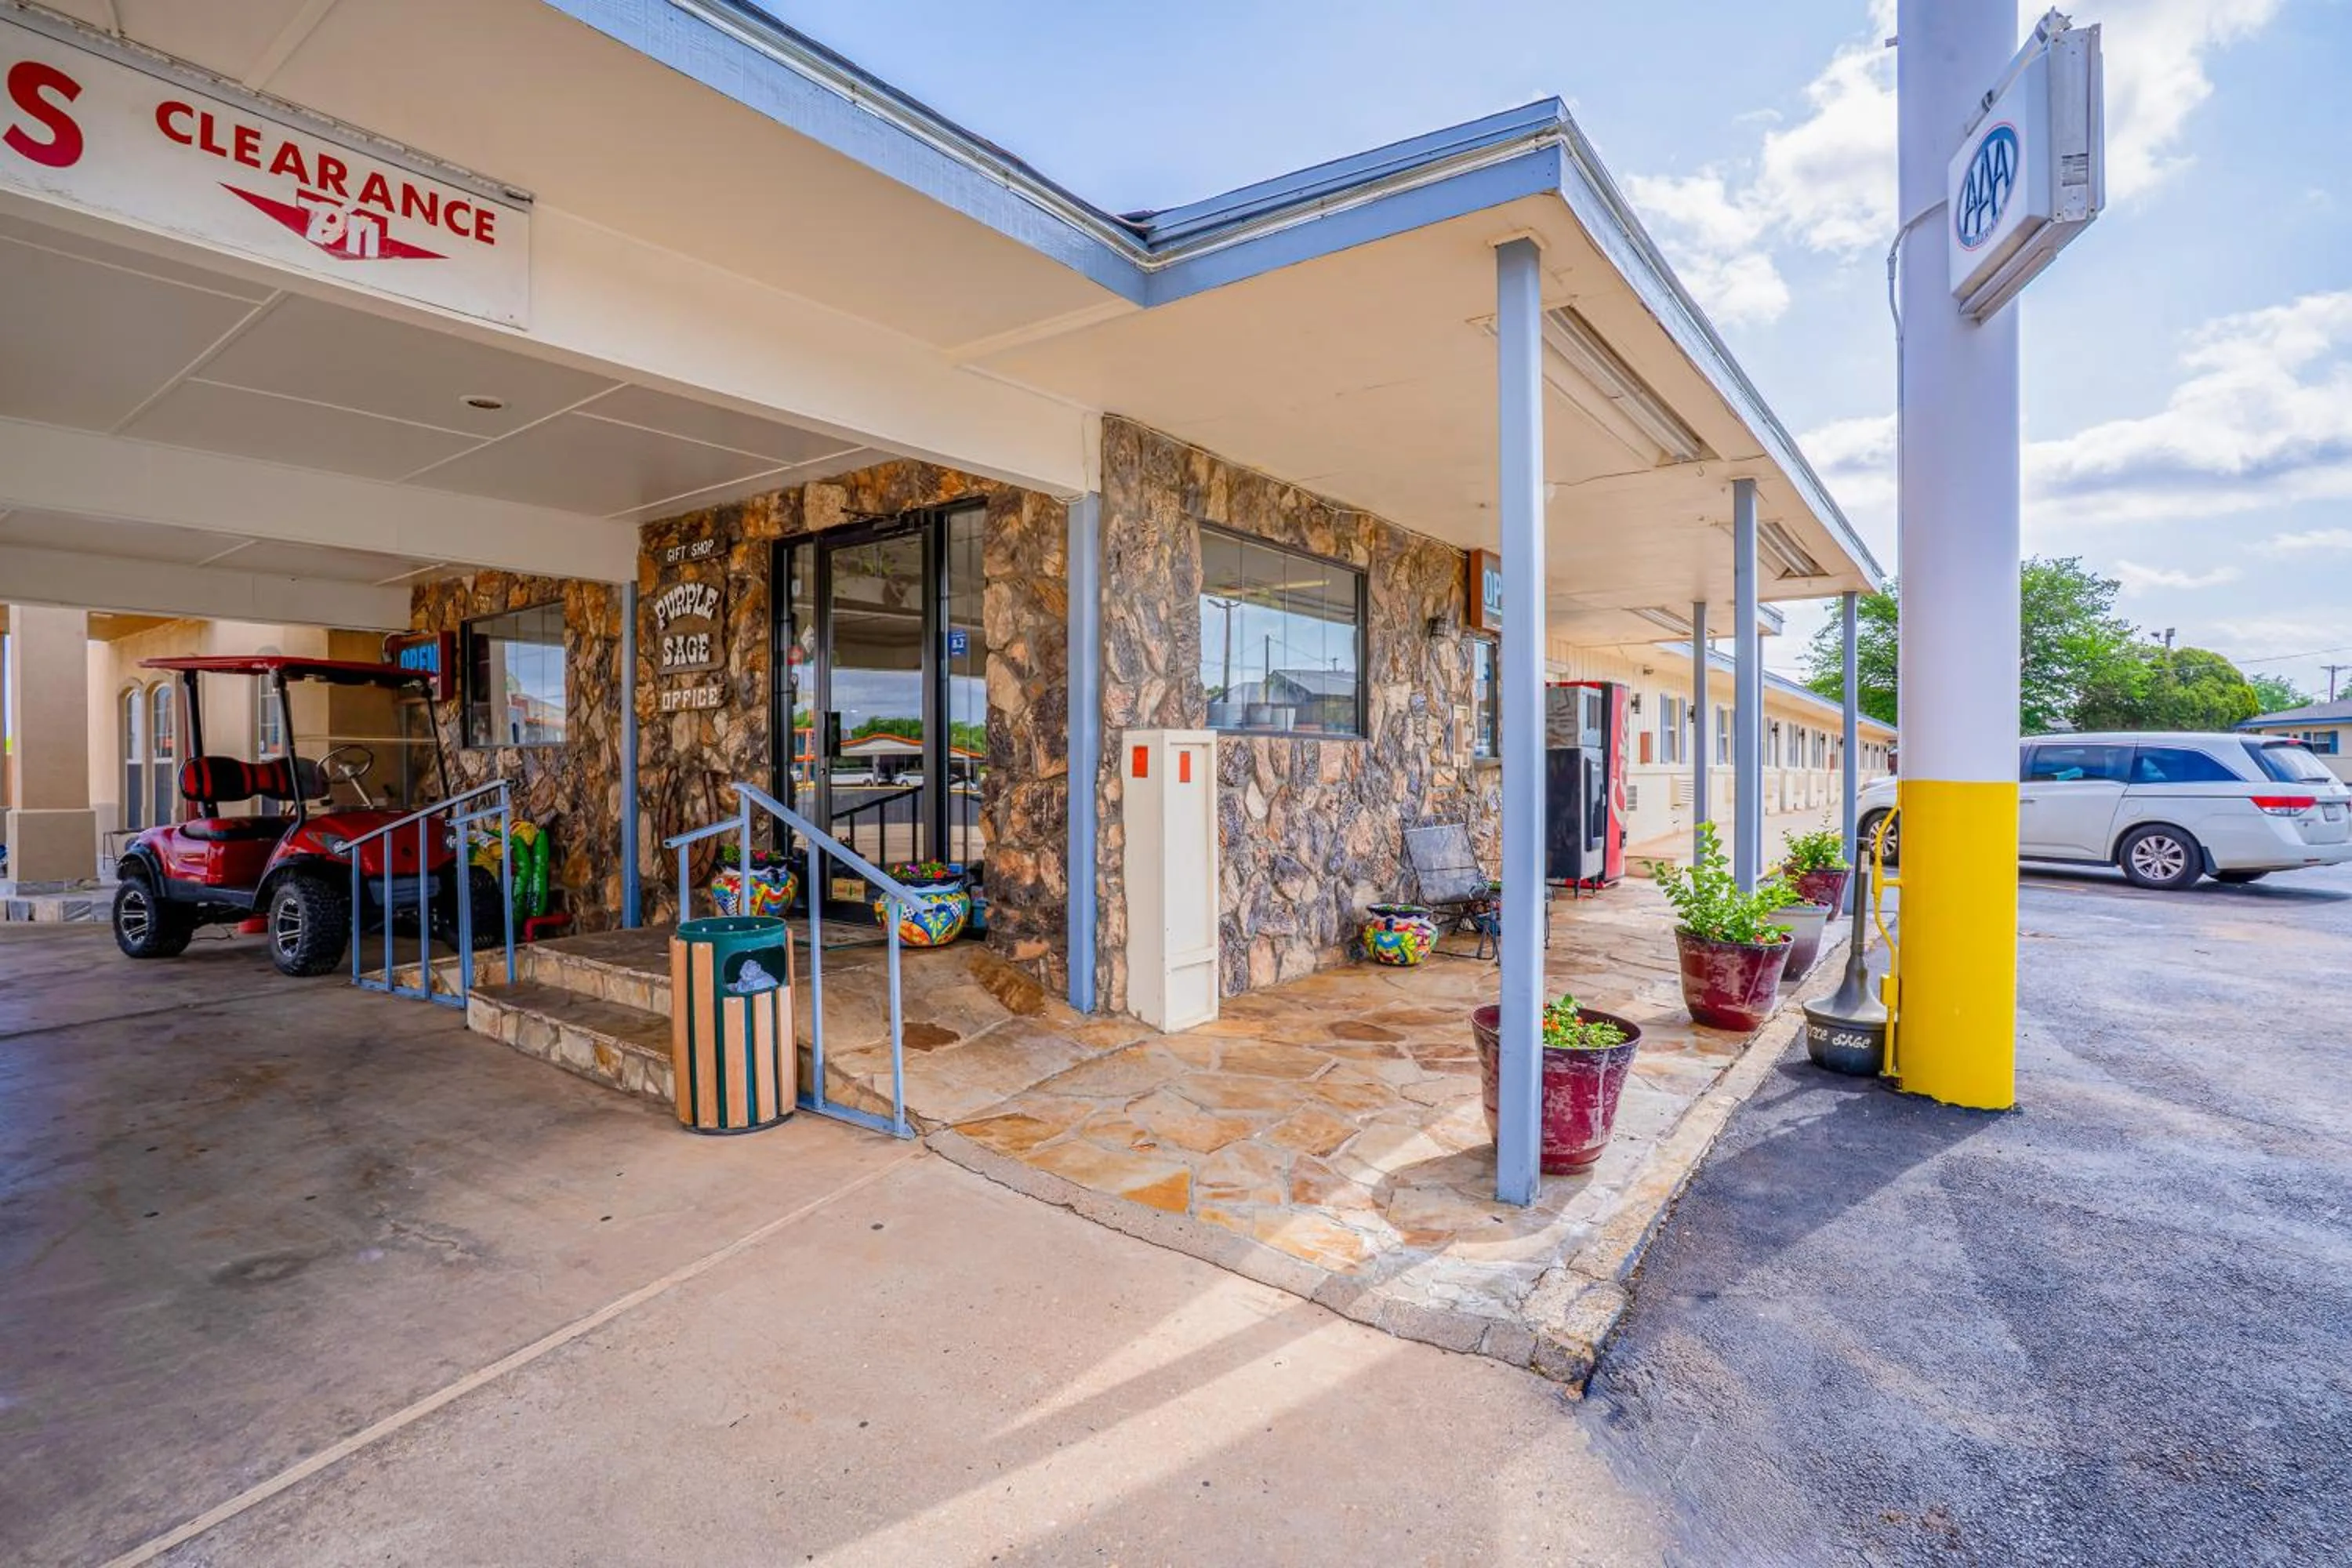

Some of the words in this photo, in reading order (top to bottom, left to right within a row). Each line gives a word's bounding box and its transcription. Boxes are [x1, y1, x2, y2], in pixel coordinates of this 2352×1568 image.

[155, 101, 495, 245] CLEARANCE
[1964, 140, 2009, 235] AAA
[667, 545, 687, 562] GIFT
[691, 539, 714, 557] SHOP
[654, 583, 719, 631] PURPLE
[662, 632, 710, 666] SAGE
[662, 687, 718, 710] OFFICE
